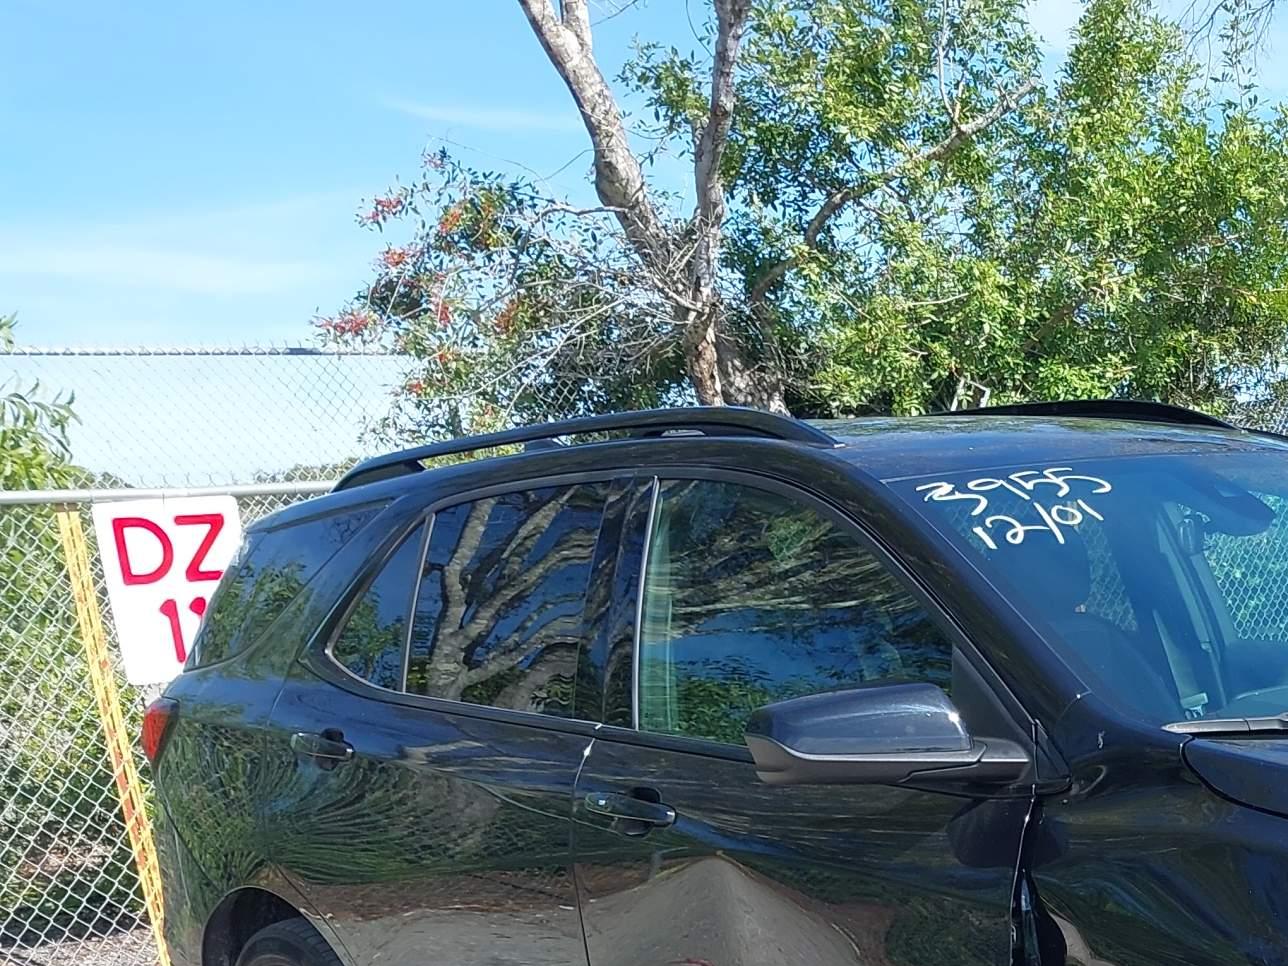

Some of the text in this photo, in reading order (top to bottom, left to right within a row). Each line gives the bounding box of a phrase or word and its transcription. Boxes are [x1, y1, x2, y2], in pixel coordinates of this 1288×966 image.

[916, 467, 1112, 516] 3955
[112, 513, 225, 585] DZ
[972, 499, 1104, 550] 12/01
